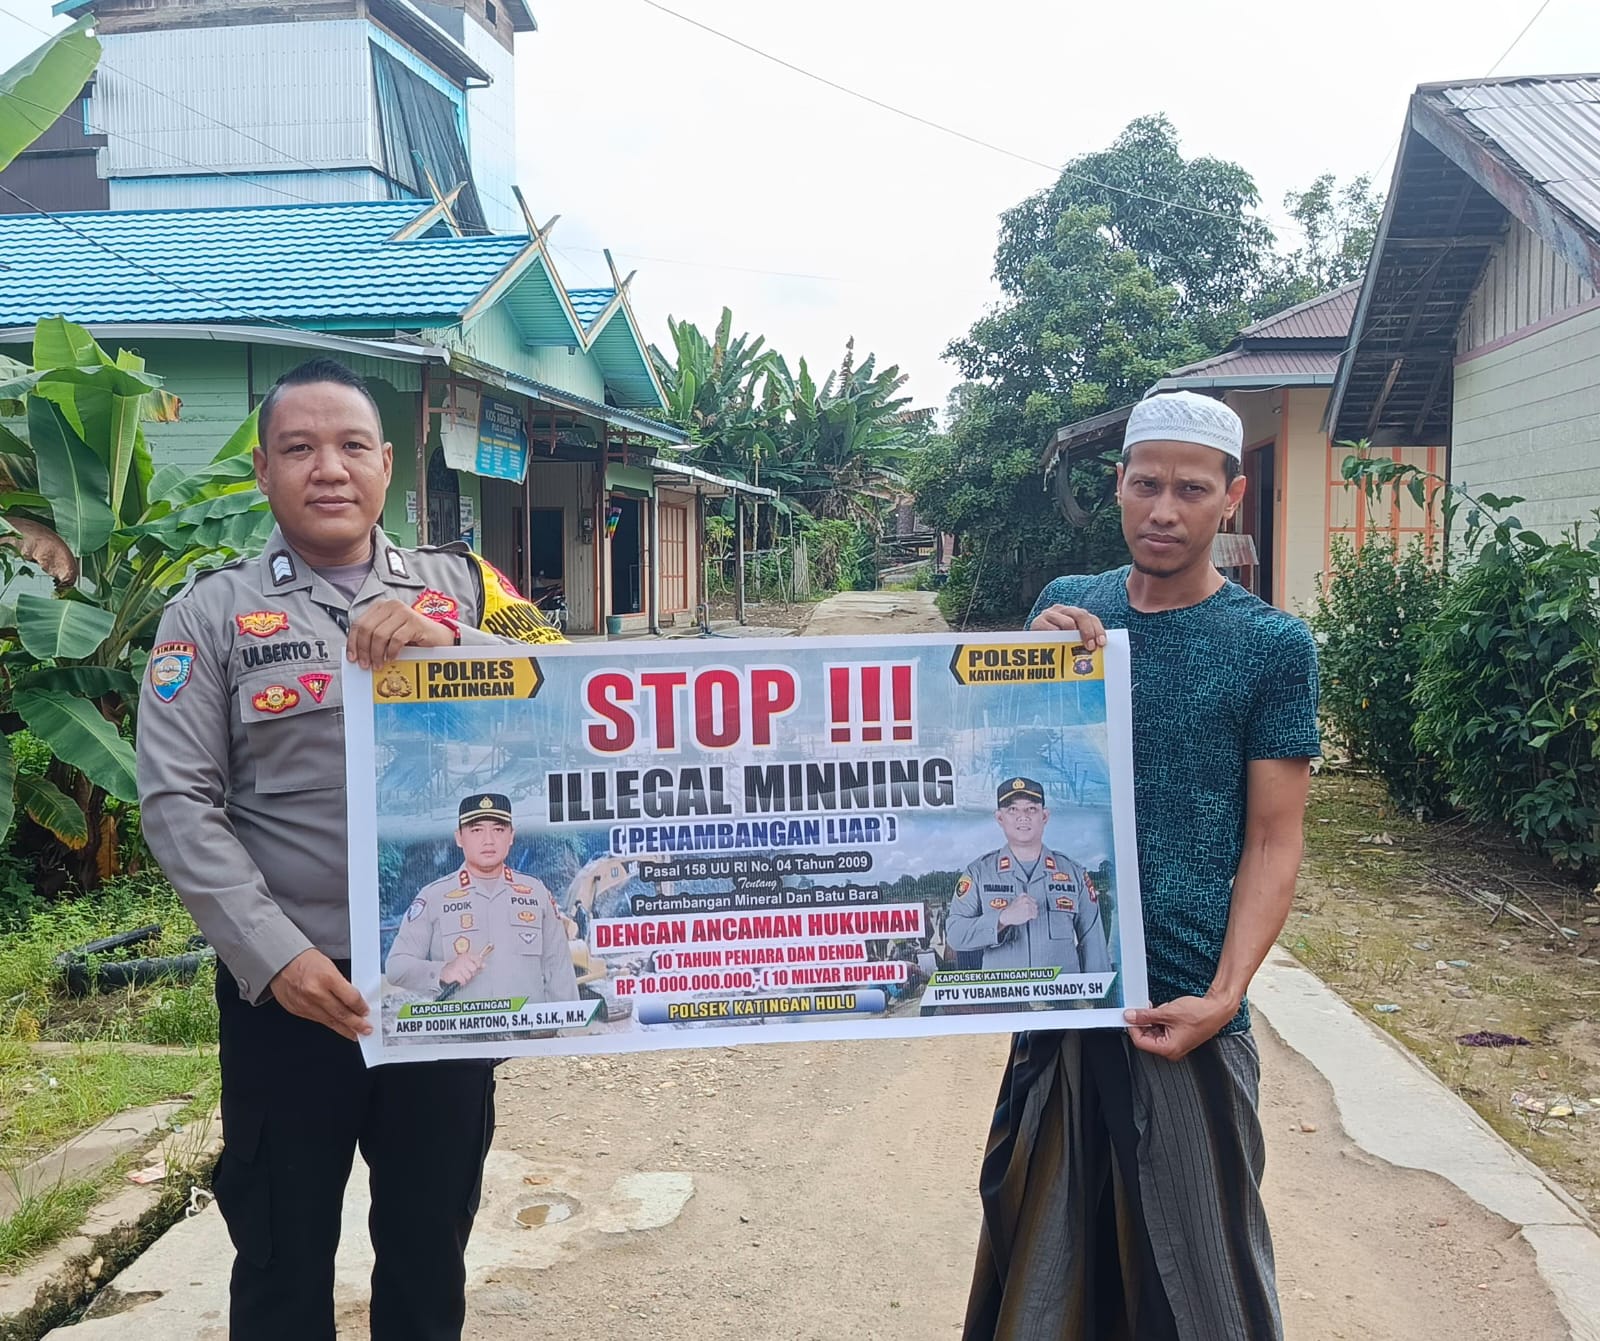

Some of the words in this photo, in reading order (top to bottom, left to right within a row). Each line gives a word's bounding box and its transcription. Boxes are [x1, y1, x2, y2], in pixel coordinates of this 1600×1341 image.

[242, 641, 312, 668] ULBERTO
[315, 640, 329, 658] T.
[968, 648, 1056, 668] POLSEK
[427, 660, 515, 682] POLRES
[968, 669, 1025, 682] KATINGAN
[1027, 667, 1056, 680] HULU
[428, 681, 515, 699] KATINGAN
[585, 667, 798, 753] STOP
[828, 664, 914, 744] !!!
[547, 766, 733, 824] ILLEGAL
[743, 757, 956, 814] MINNING
[643, 864, 680, 878] Pasal
[684, 863, 707, 876] 158
[710, 862, 730, 875] UU
[734, 861, 748, 873] RI
[751, 860, 773, 873] No.
[776, 858, 792, 871] 04
[795, 857, 835, 870] Tahun
[838, 855, 869, 869] 2009
[737, 876, 778, 891] Tentang
[1048, 883, 1076, 893] POLRI
[443, 901, 473, 913] DODIK
[510, 896, 539, 907] POLRI
[635, 896, 731, 913] Pertambangan
[735, 892, 782, 907] Mineral
[786, 891, 811, 904] Dan
[815, 889, 845, 903] Batu
[849, 888, 879, 901] Bara
[596, 920, 686, 948] DENGAN
[691, 914, 803, 943] ANCAMAN
[807, 909, 920, 937] HUKUMAN
[656, 953, 673, 970] 10
[675, 951, 722, 969] TAHUN
[724, 948, 785, 967] PENJARA
[787, 946, 816, 963] DAN
[818, 943, 865, 961] DENDA
[615, 979, 637, 996] RP.
[791, 967, 841, 985] MILYAR
[935, 973, 983, 984] KAPOLSEK
[983, 971, 1028, 982] KATINGAN
[1030, 969, 1054, 979] HULU
[934, 987, 960, 1001] IPTU
[962, 985, 1031, 1000] YUBAMBANG
[1032, 983, 1087, 998] KUSNADY,
[1088, 982, 1104, 994] SH
[411, 1004, 461, 1016] KAPOLRES
[462, 999, 511, 1013] KATINGAN
[668, 1001, 729, 1019] POLSEK
[734, 997, 811, 1016] KATINGAN
[815, 993, 856, 1011] HULU
[396, 1020, 423, 1033] AKBP
[425, 1019, 457, 1032] DODIK
[459, 1016, 510, 1031] HARTONO,
[566, 1010, 587, 1023] M.H.
